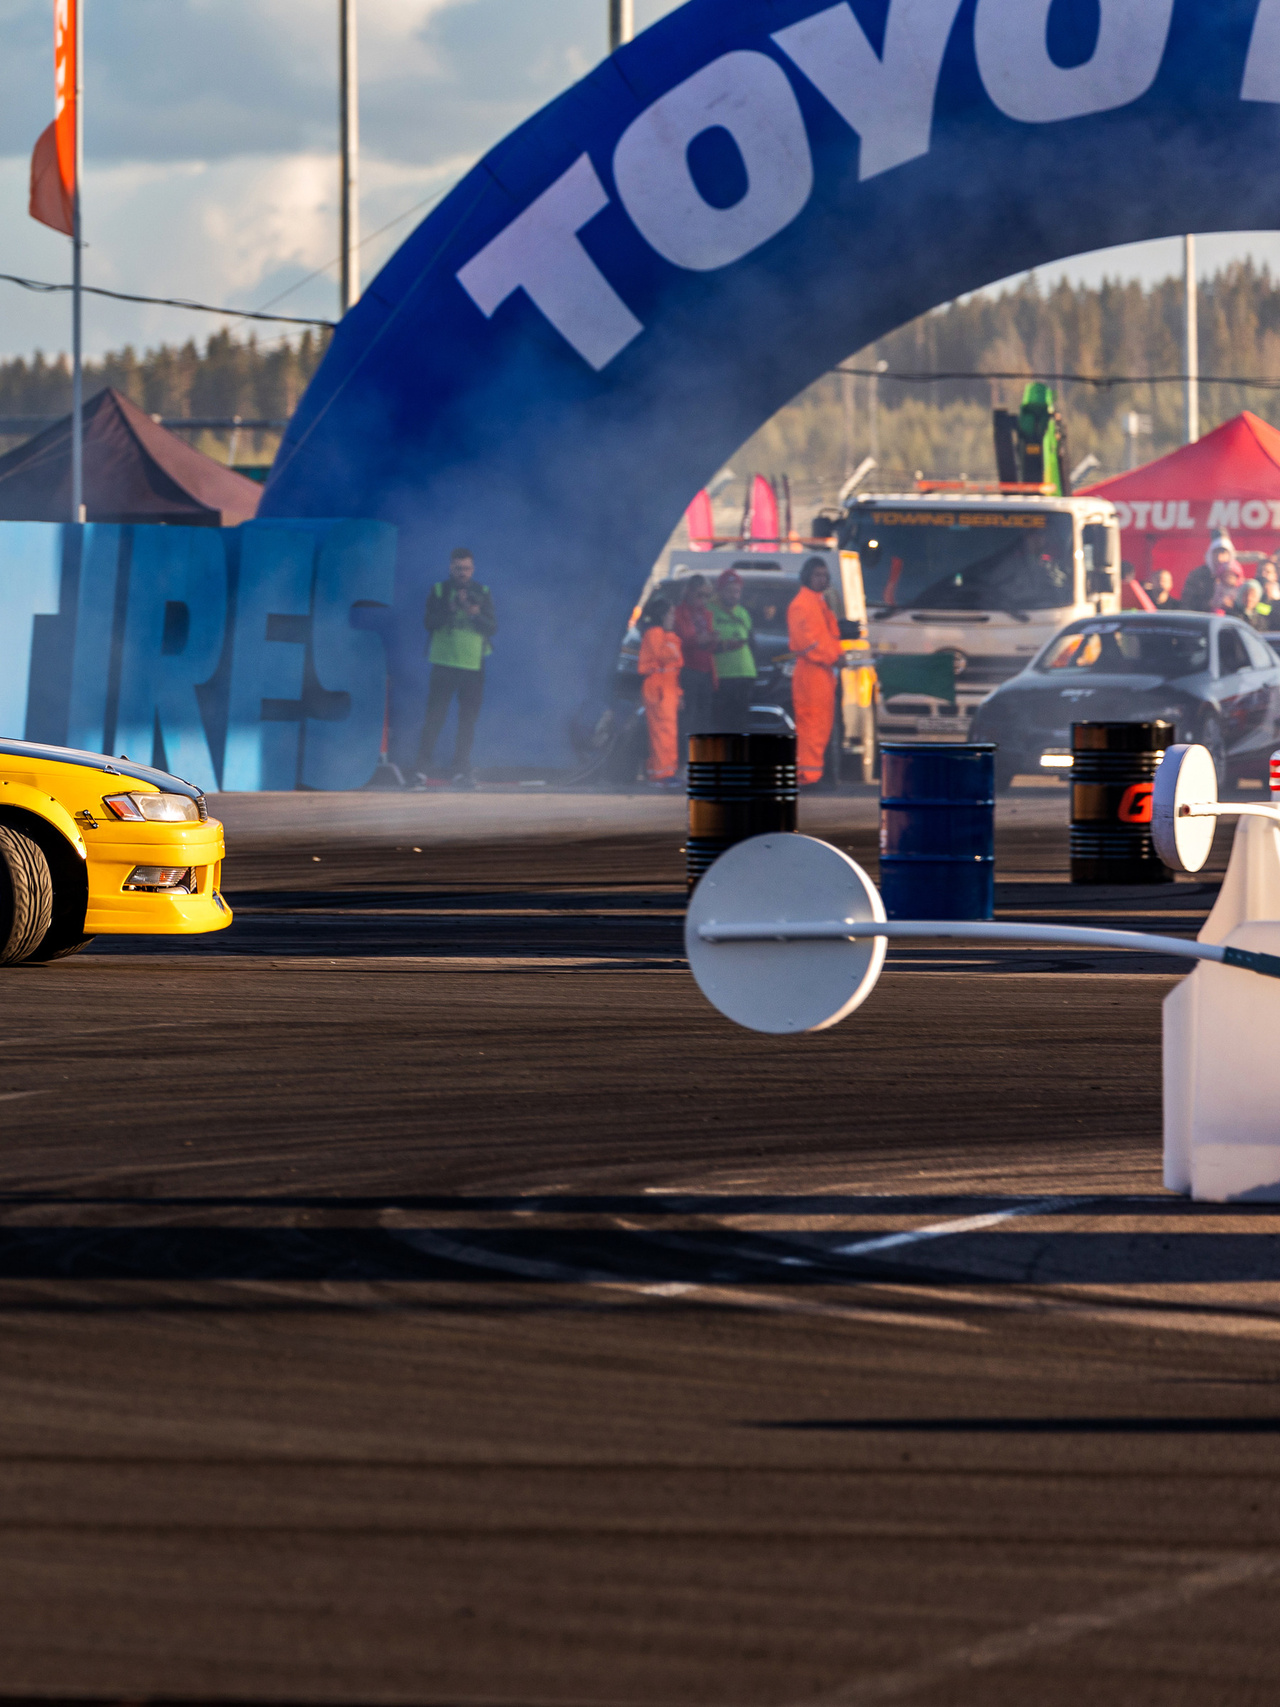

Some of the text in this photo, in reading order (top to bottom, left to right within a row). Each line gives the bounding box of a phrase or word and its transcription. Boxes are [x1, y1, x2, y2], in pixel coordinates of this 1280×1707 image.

[455, 0, 1174, 372] TOYO
[872, 513, 1046, 528] TOWING SERVICE
[1113, 501, 1196, 530] OTUL
